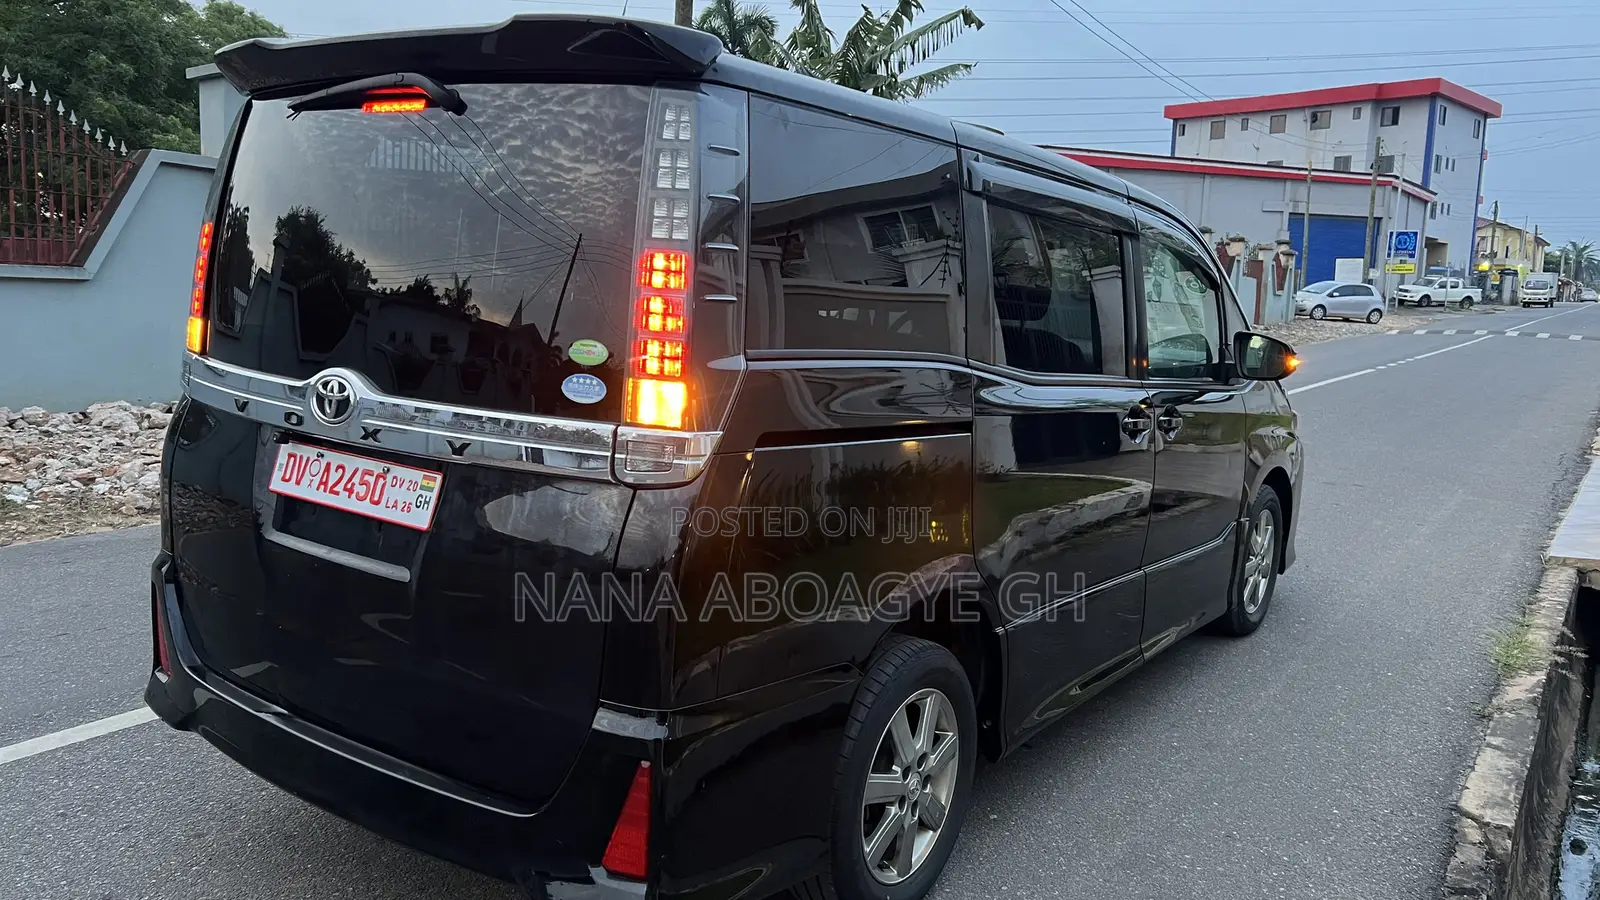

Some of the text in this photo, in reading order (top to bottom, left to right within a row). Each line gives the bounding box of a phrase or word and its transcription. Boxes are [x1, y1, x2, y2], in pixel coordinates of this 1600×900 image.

[234, 398, 472, 457] VOXY
[280, 452, 388, 506] DV A2450
[390, 475, 419, 492] DV 20
[385, 497, 413, 513] LA 26
[415, 493, 432, 511] GH
